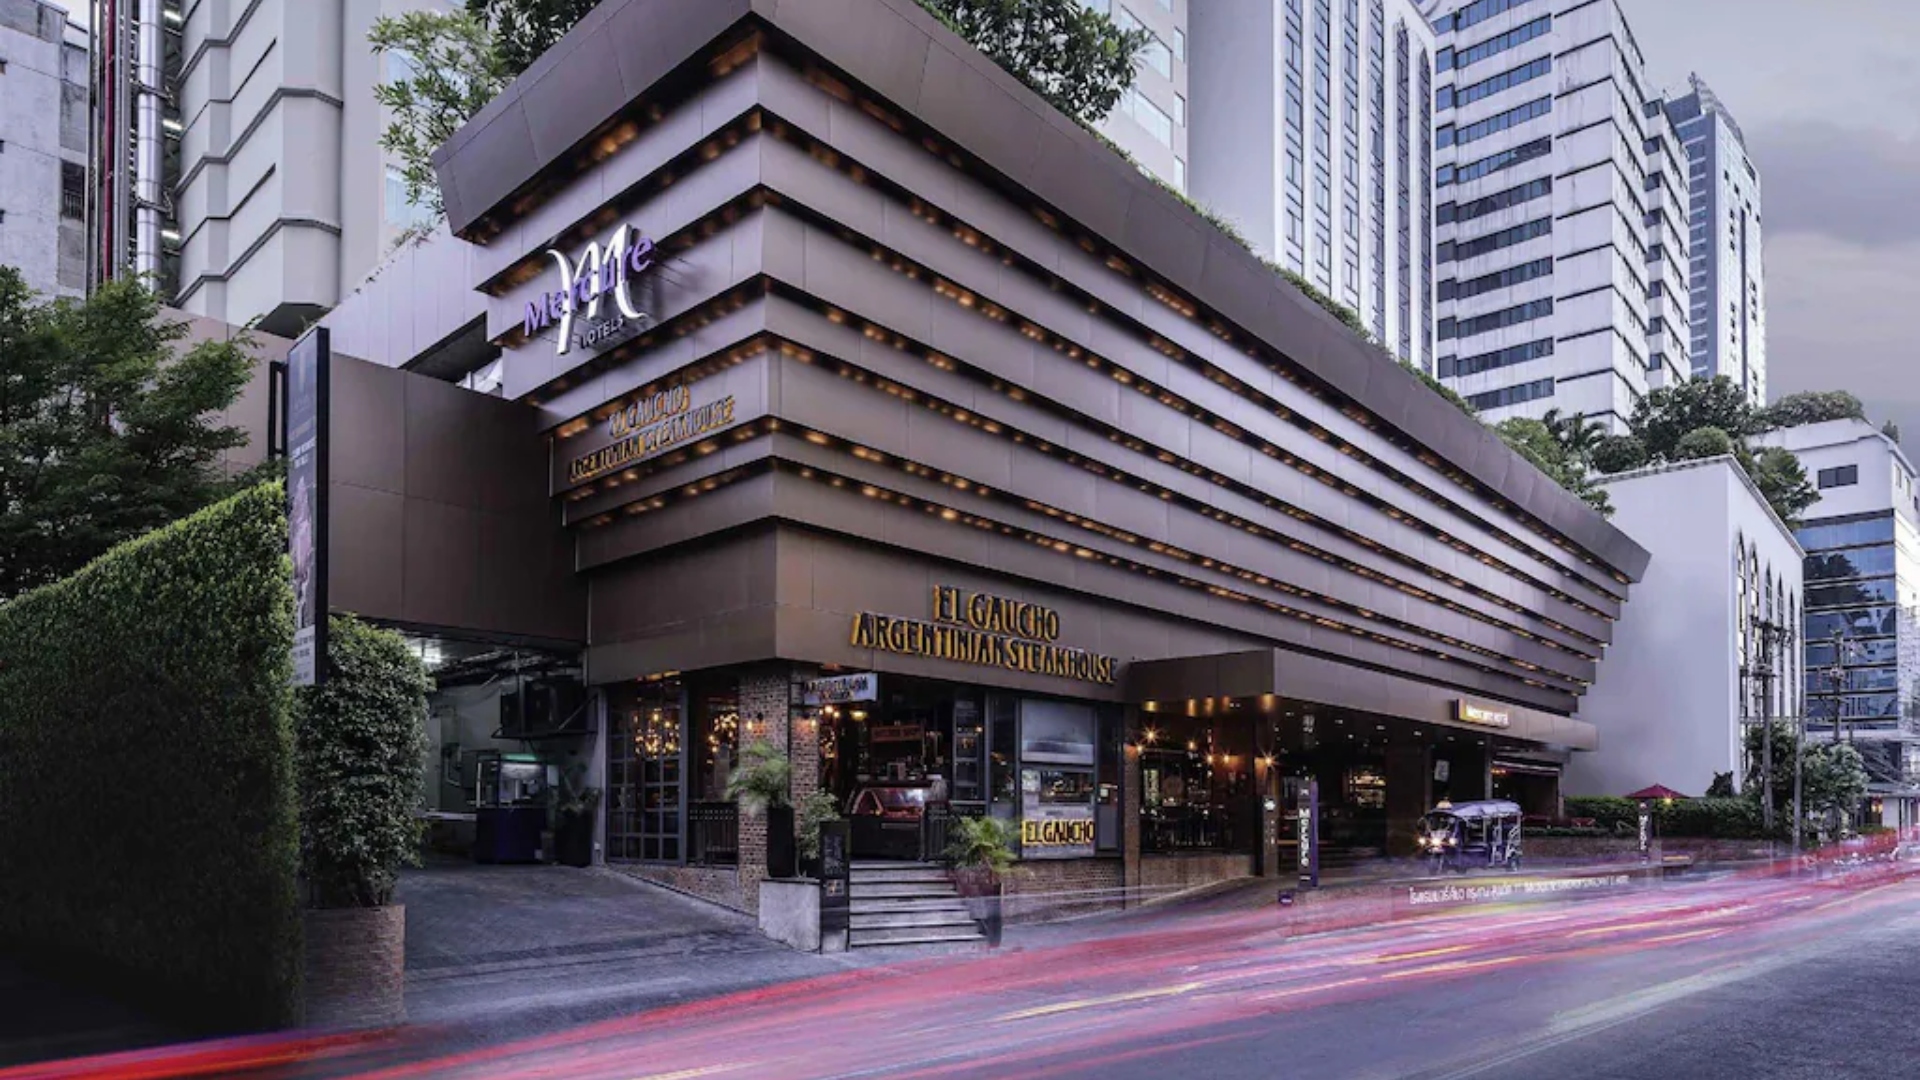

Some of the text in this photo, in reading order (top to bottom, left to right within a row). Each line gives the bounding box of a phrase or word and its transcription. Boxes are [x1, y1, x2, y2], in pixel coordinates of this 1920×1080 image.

[524, 235, 654, 337] Mercure
[580, 318, 624, 349] HOTELS
[933, 584, 1061, 642] EL GAUCHO
[851, 610, 1119, 684] ARGENTINIAN STEAKHOUSE
[1021, 819, 1096, 846] EL GAUCHO
[1299, 807, 1312, 867] Mercure
